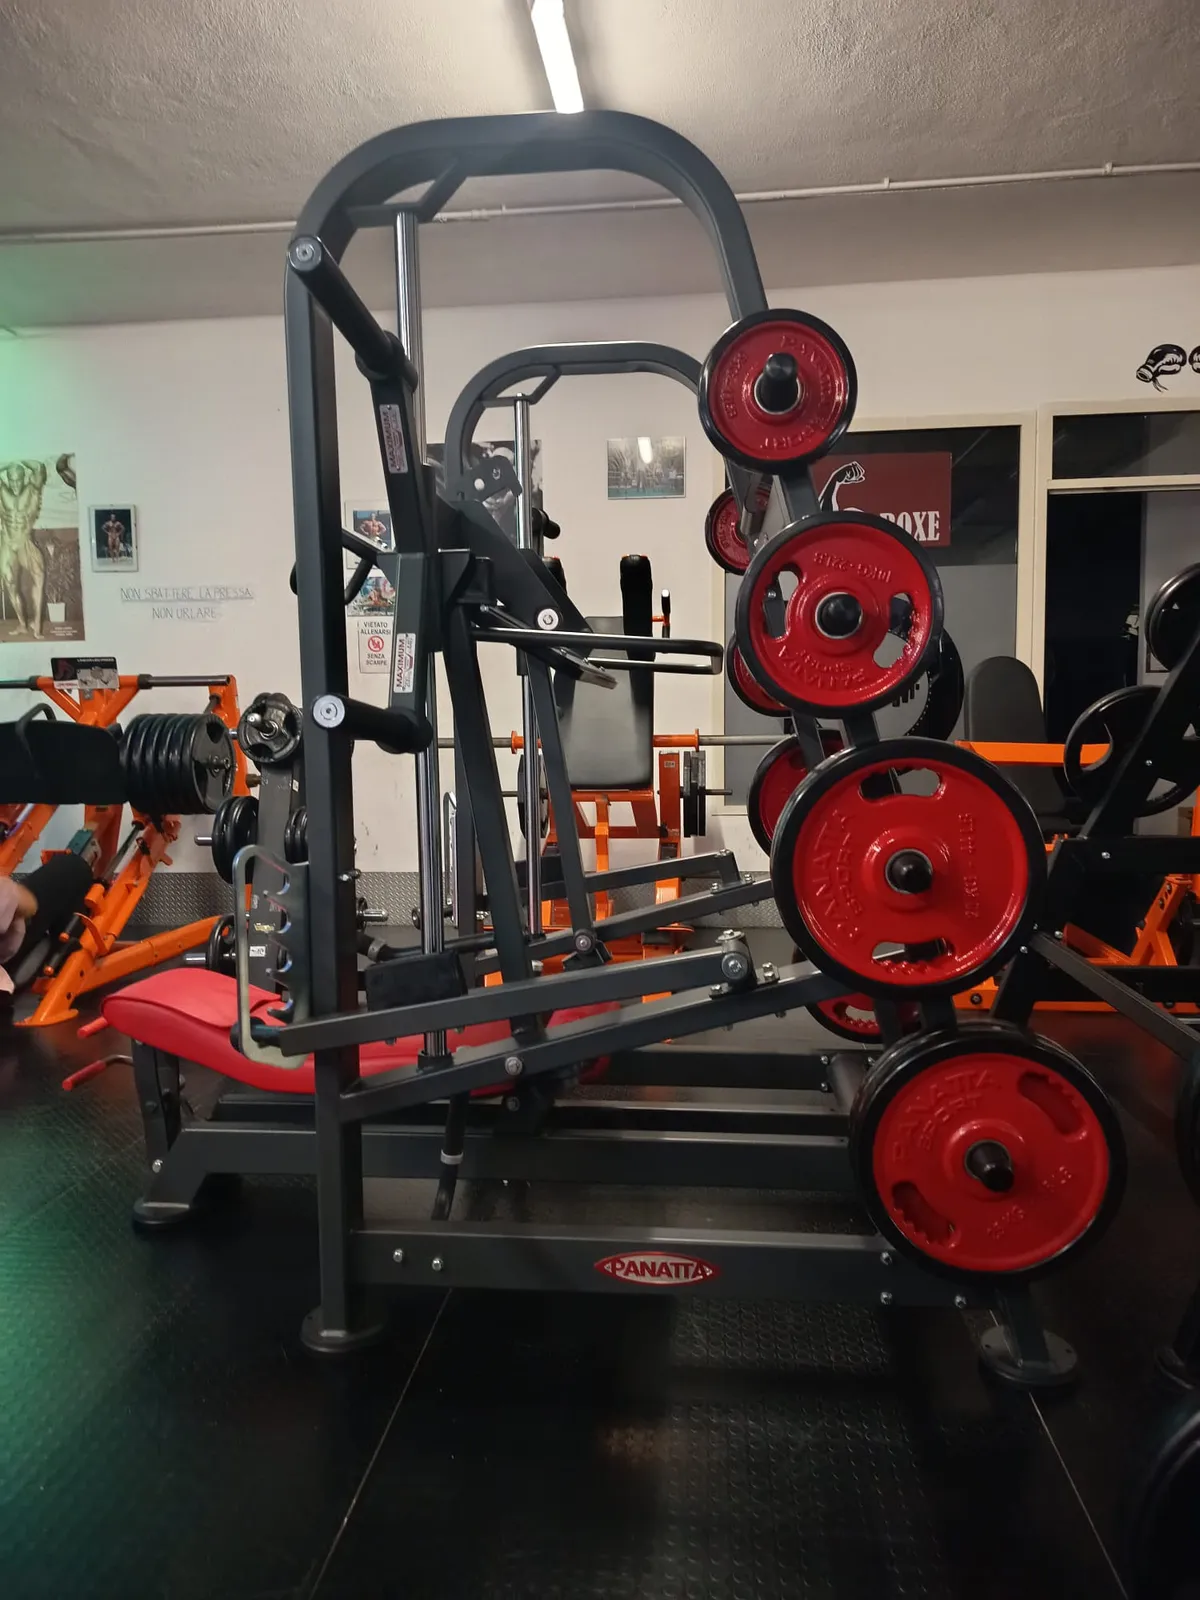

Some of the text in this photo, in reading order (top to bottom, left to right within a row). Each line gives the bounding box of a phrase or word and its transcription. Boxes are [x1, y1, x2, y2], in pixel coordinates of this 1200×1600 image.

[381, 411, 397, 469] MAXIMUM
[120, 587, 141, 600] NON
[152, 607, 173, 619] NON
[396, 638, 405, 688] MAXIMUM
[611, 1257, 708, 1279] PANATTA
